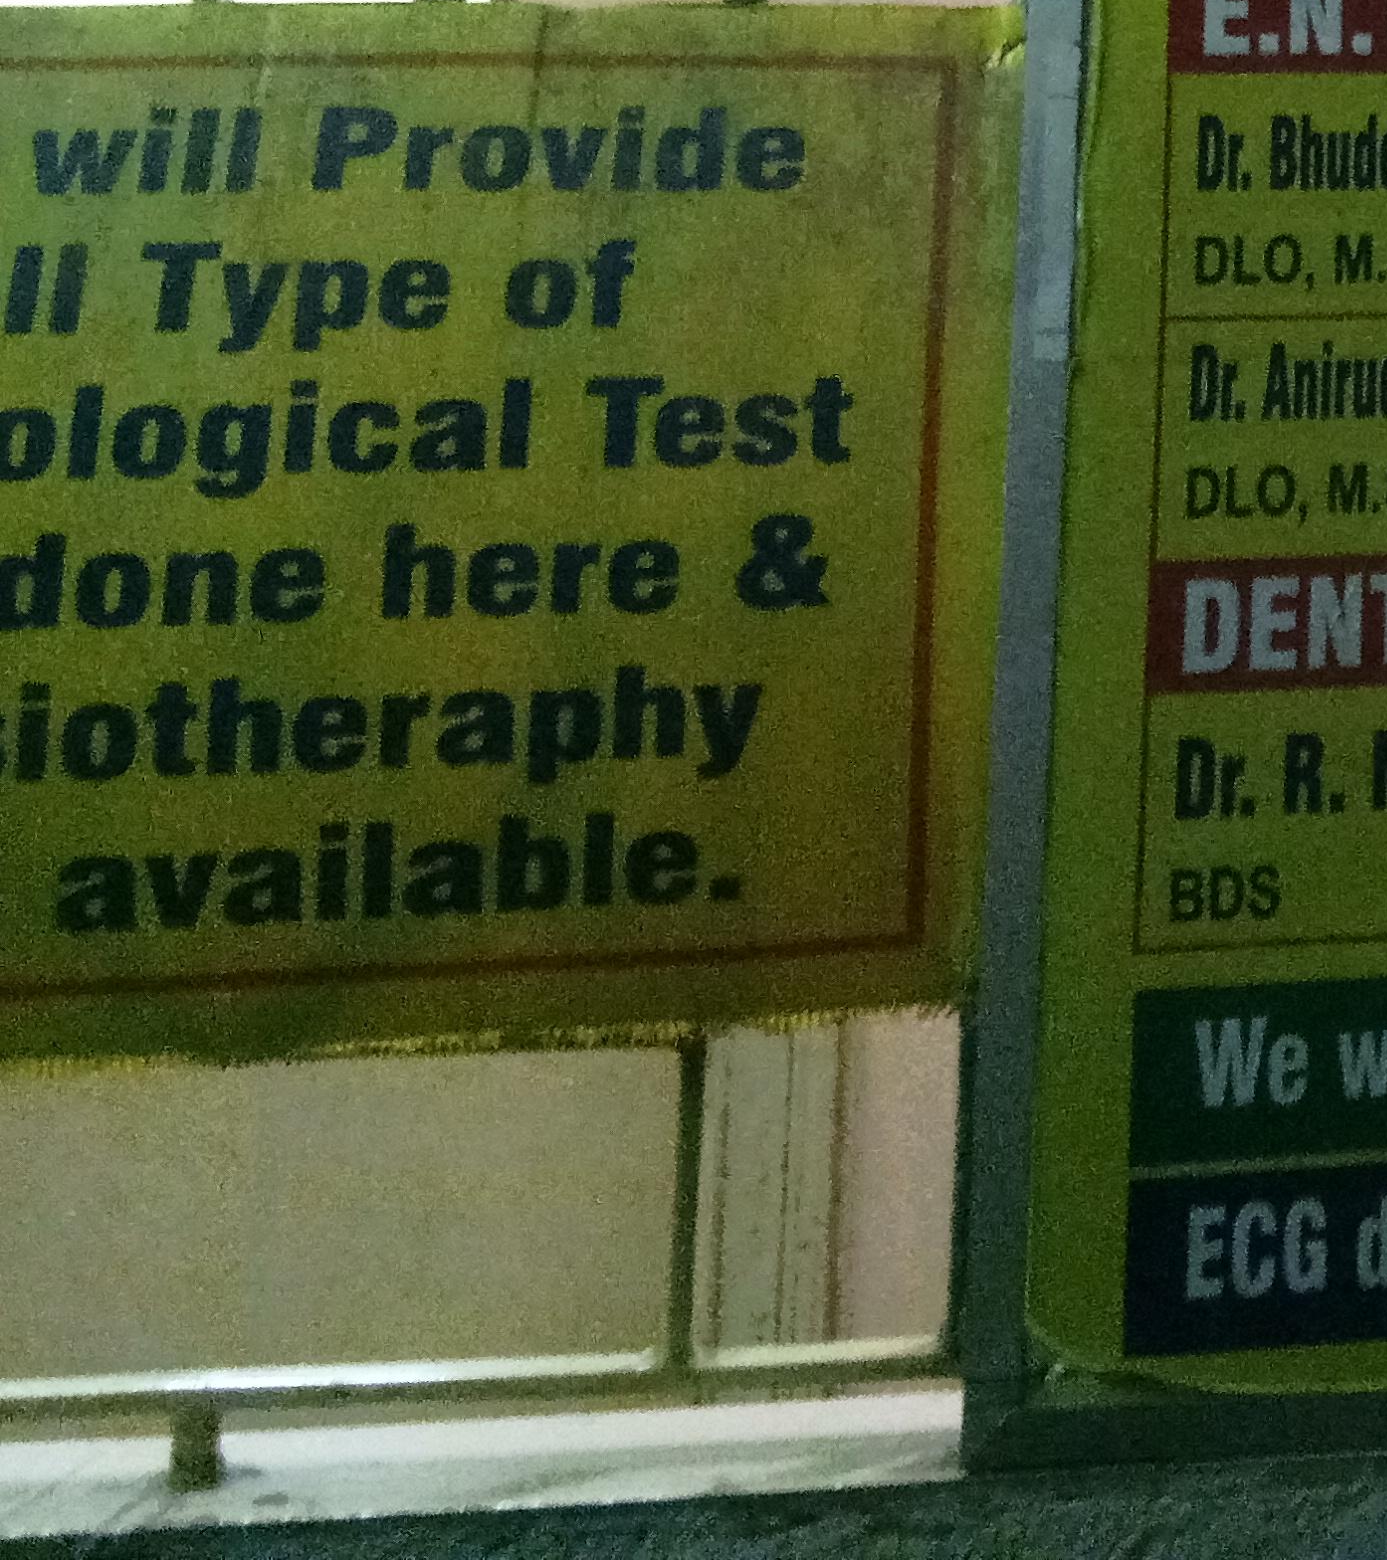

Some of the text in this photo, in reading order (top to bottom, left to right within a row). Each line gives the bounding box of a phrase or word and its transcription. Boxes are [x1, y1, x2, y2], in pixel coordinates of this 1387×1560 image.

[33, 106, 806, 195] will Provide
[1197, 114, 1251, 191] Dr.
[142, 240, 450, 352] Type
[504, 239, 636, 330] of
[1193, 235, 1314, 290] DLO,
[588, 375, 853, 470] Test
[1189, 344, 1246, 422] Dr.
[1184, 465, 1307, 524] DLO,
[0, 513, 829, 629] done here &
[0, 666, 762, 783] iotheraphy
[1174, 735, 1256, 820] Dr.
[1283, 731, 1345, 815] R.
[56, 812, 741, 932] available.
[1169, 864, 1282, 922] BDS
[1195, 1015, 1309, 1108] We
[1186, 1196, 1326, 1301] ECG
